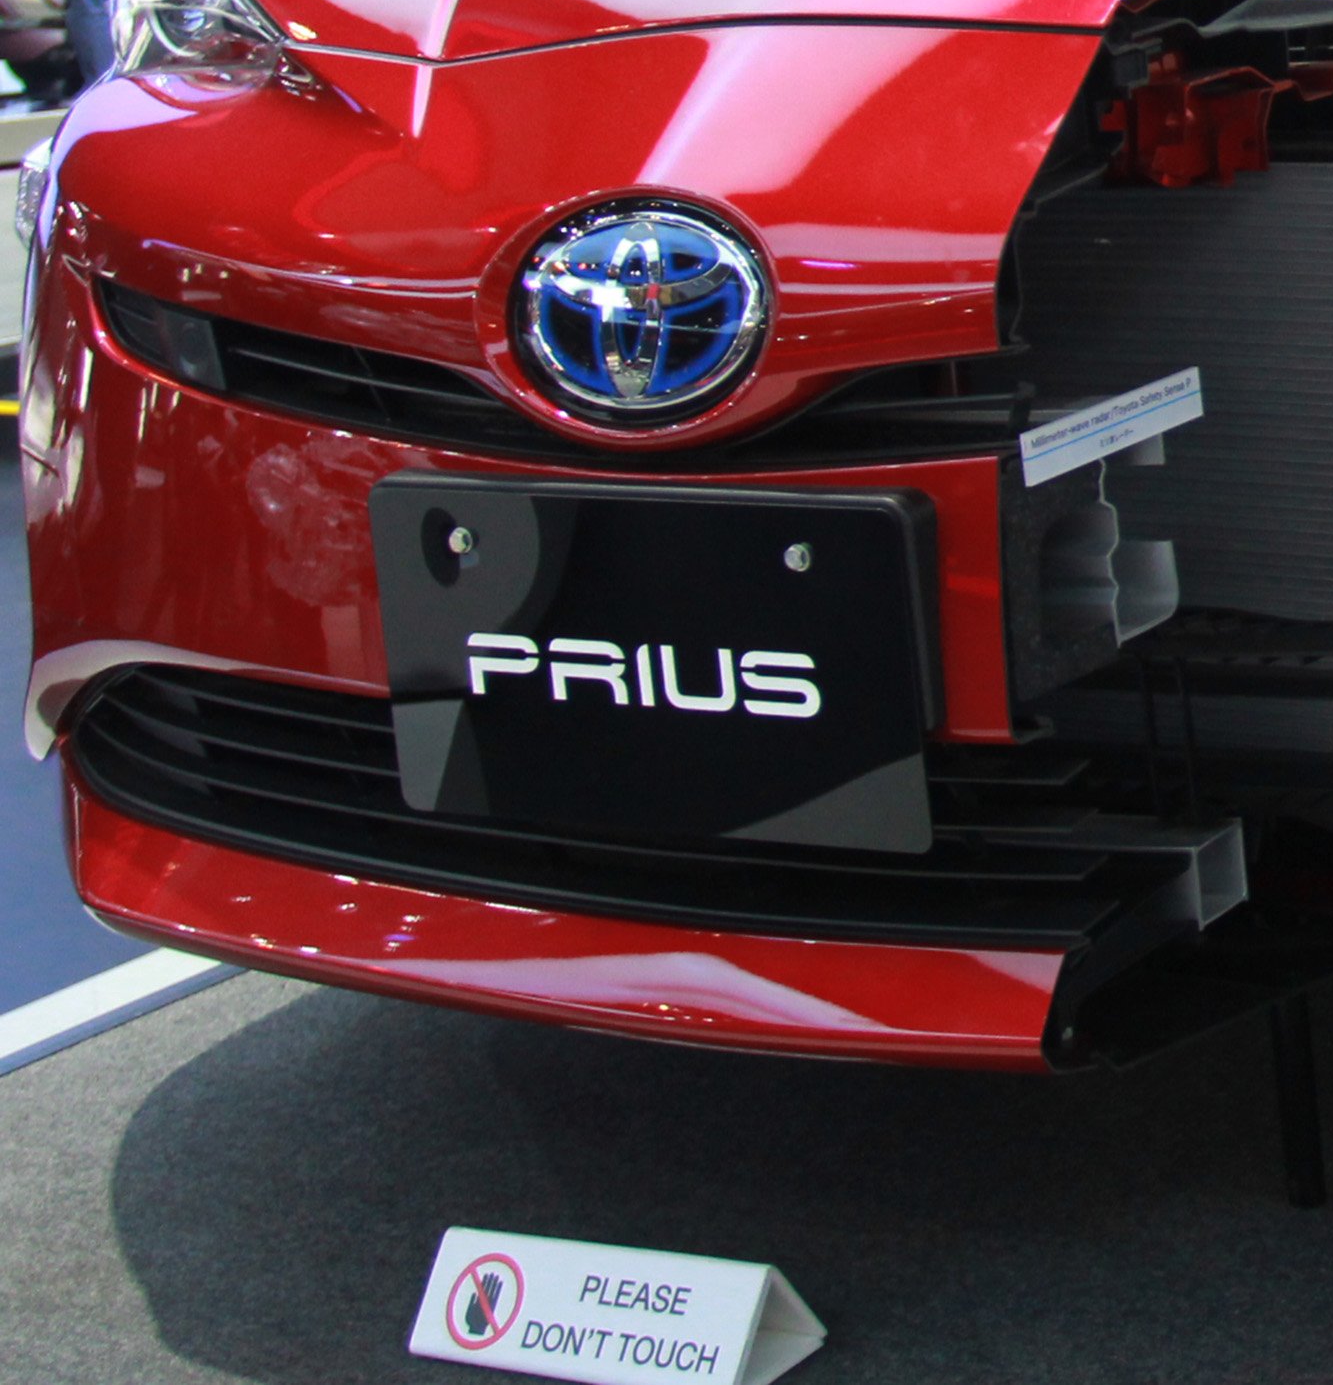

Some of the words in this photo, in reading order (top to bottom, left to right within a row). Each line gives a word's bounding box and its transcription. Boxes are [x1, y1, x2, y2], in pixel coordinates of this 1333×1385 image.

[467, 632, 822, 719] PRIUS
[579, 1274, 692, 1316] PLEASE
[520, 1319, 613, 1361] DON'T
[616, 1331, 720, 1375] TOUCH
